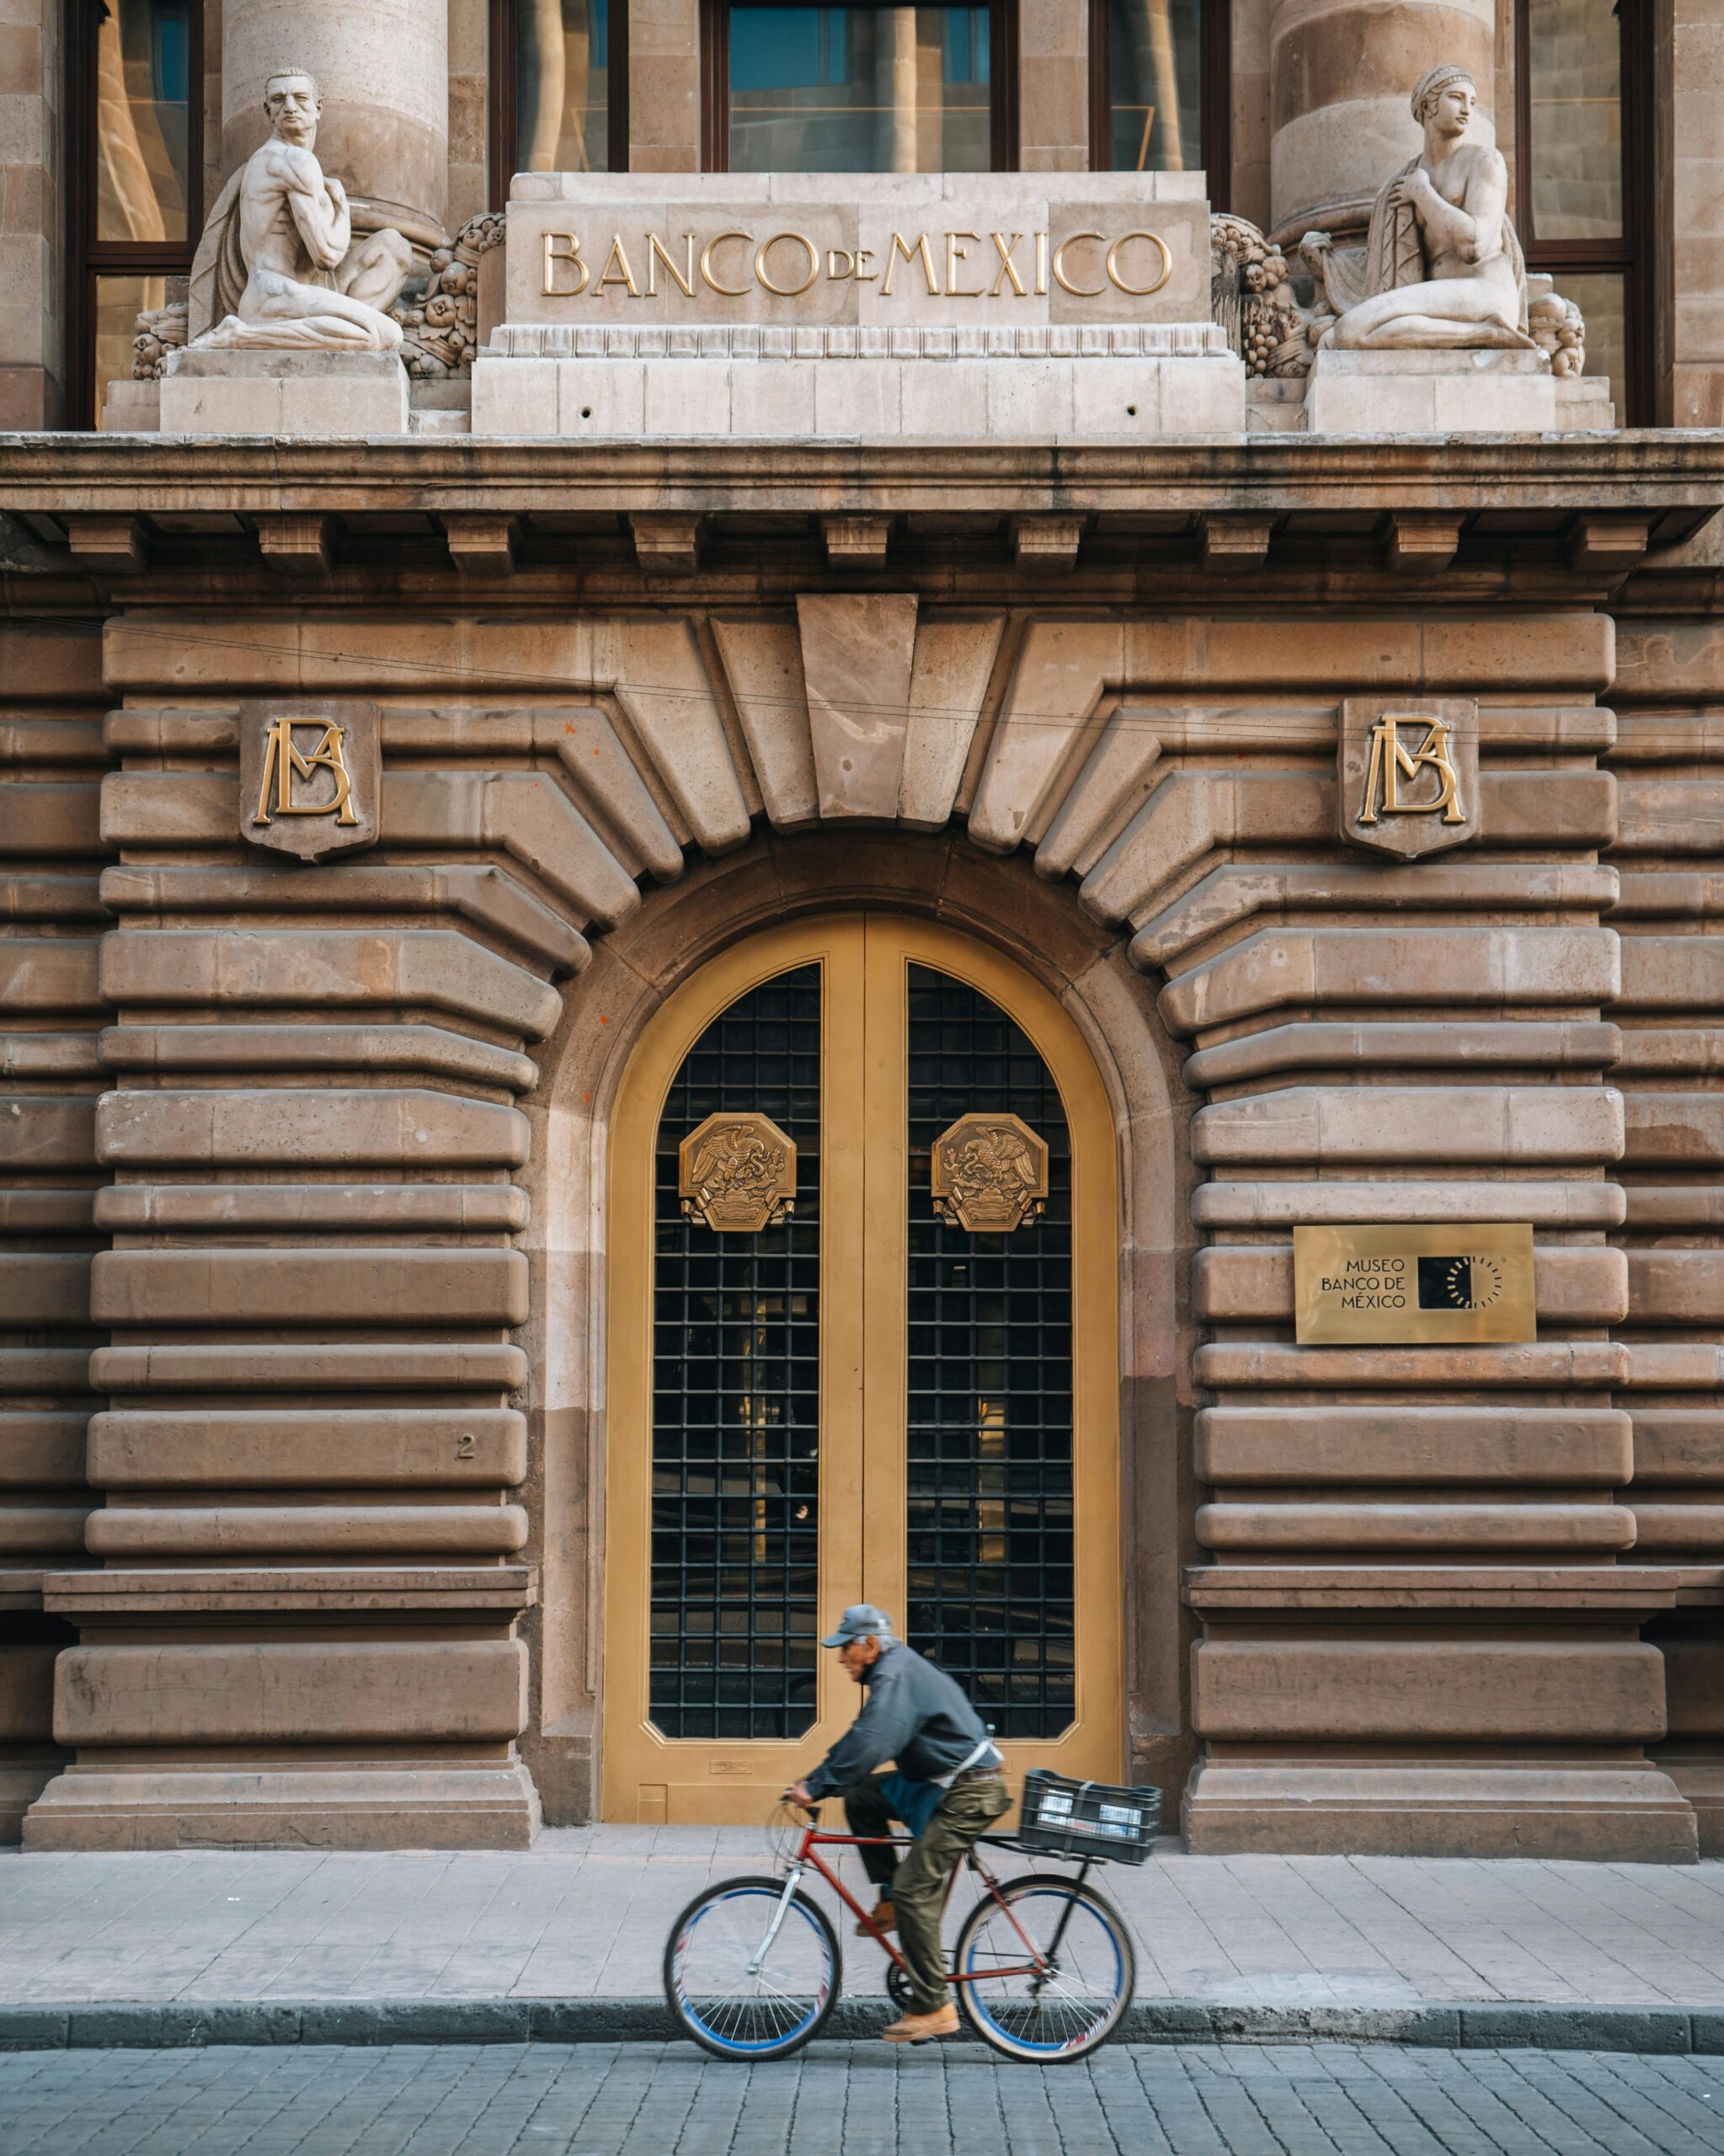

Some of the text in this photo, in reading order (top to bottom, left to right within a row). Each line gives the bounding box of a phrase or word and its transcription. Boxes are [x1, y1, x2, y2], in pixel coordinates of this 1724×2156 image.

[541, 230, 1173, 297] BANCO DE MEXICO
[1346, 1258, 1405, 1273] MUSEO
[1321, 1277, 1406, 1290] BANCO DE
[1341, 1292, 1406, 1309] MÉXICO
[457, 1433, 476, 1459] 2
